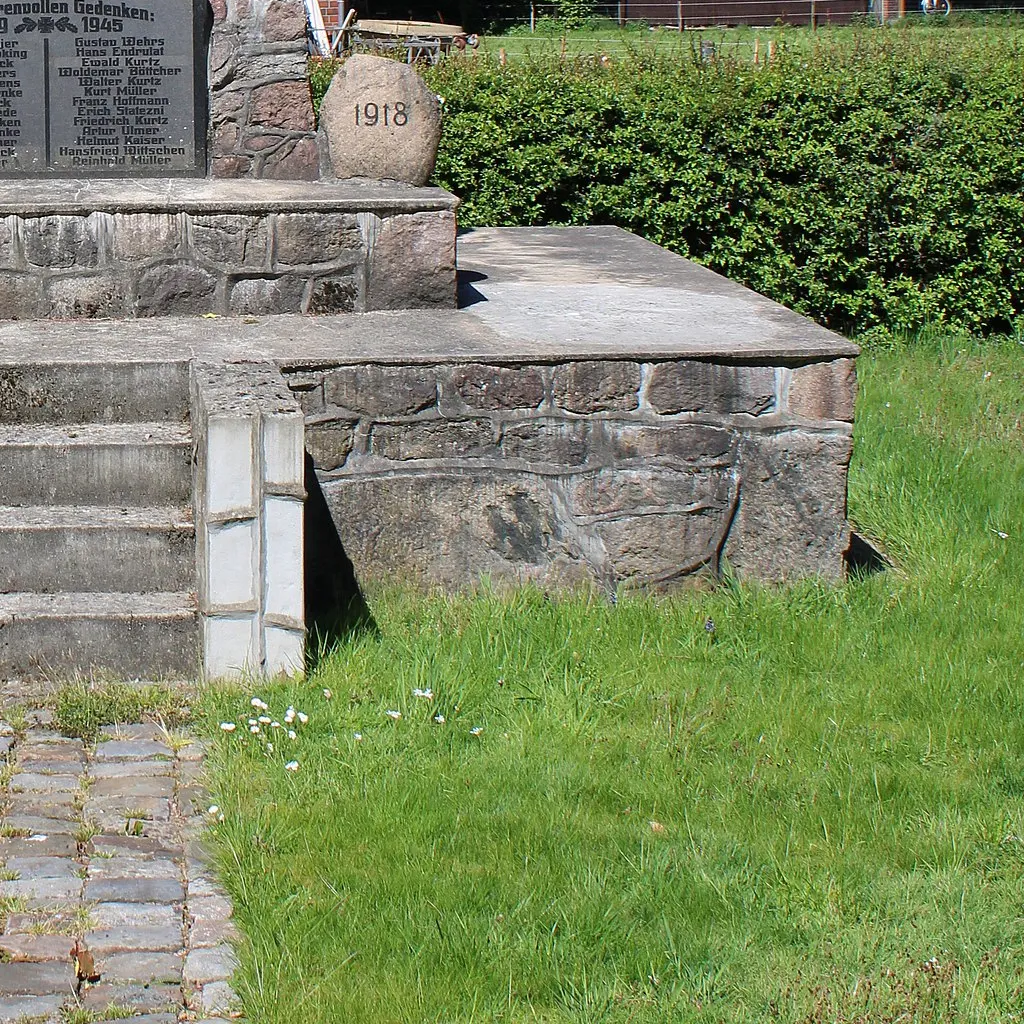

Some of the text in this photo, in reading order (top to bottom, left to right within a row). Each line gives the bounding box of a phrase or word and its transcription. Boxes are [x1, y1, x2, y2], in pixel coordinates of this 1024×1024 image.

[74, 0, 155, 22] Gedenken:
[82, 16, 123, 32] 1945
[75, 37, 165, 47] Gustav Wehrs
[76, 47, 164, 56] Hans Endrulat
[81, 58, 160, 66] Ewald Kurtz
[58, 66, 182, 77] Woldemar Böttcher
[78, 77, 162, 86] Walter Kurtz
[84, 87, 157, 96] Kurt Müller
[72, 96, 169, 106] Franz Hoffmann
[77, 107, 111, 116] Erich
[355, 102, 407, 126] 1918
[74, 116, 168, 126] Friedrich Kurtz
[82, 126, 159, 136] Artur Ulmer
[76, 136, 165, 145] Helmut Kaiser
[59, 146, 185, 156] Hansfried Wittschen
[73, 156, 171, 166] Reinhold Müller
